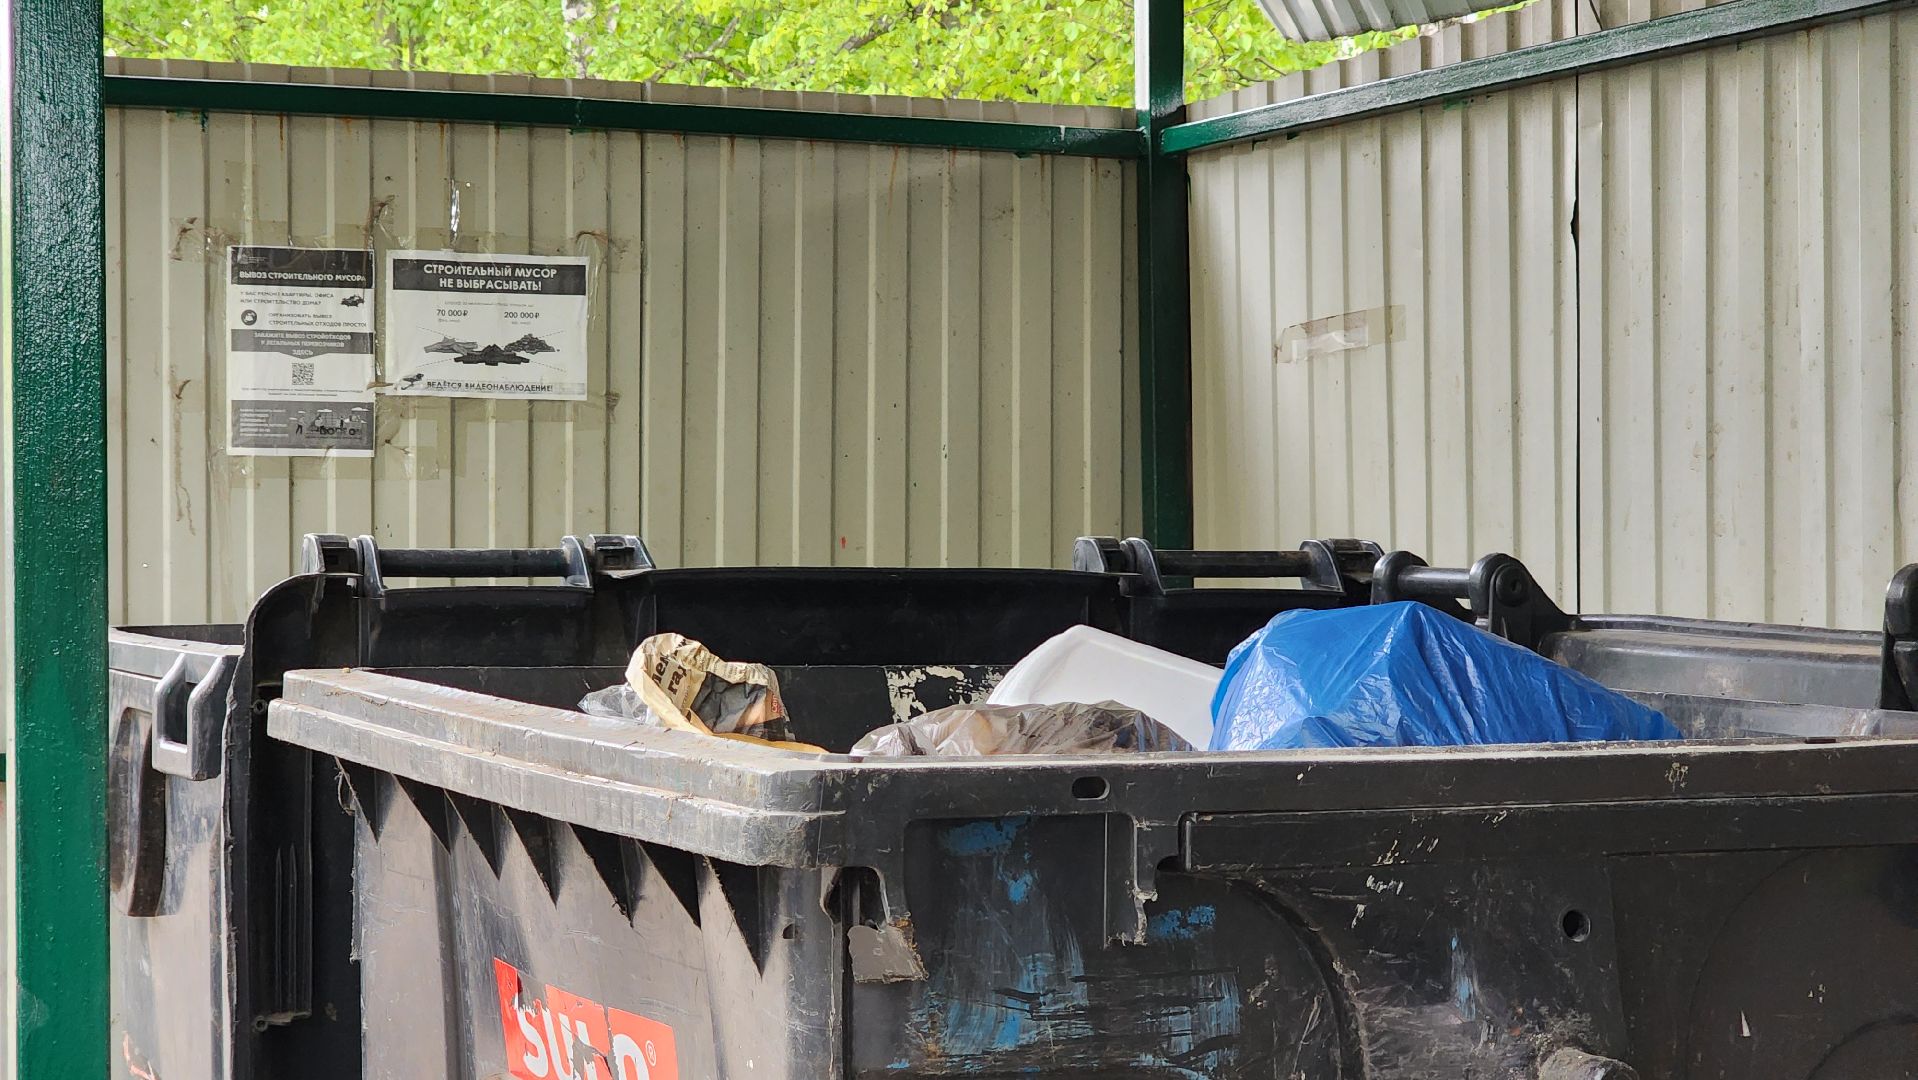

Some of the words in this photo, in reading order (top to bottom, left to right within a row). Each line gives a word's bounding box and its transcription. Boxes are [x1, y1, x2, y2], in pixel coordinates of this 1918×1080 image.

[239, 270, 267, 279] ВЫВОЗ
[268, 272, 333, 281] СТРОИТЕЛЬНОГО
[423, 264, 512, 277] СТРОИТЕЛЬНЫЙ
[514, 267, 557, 279] МУСОР
[439, 278, 454, 288] НЕ
[456, 278, 542, 291] ВЫБРАСЫВАТЬ!
[436, 309, 446, 317] 70
[426, 380, 462, 390] ВЕДЁТСЯ
[464, 382, 553, 392] ВИДЕОНАБЛЮДЕНИЕ!
